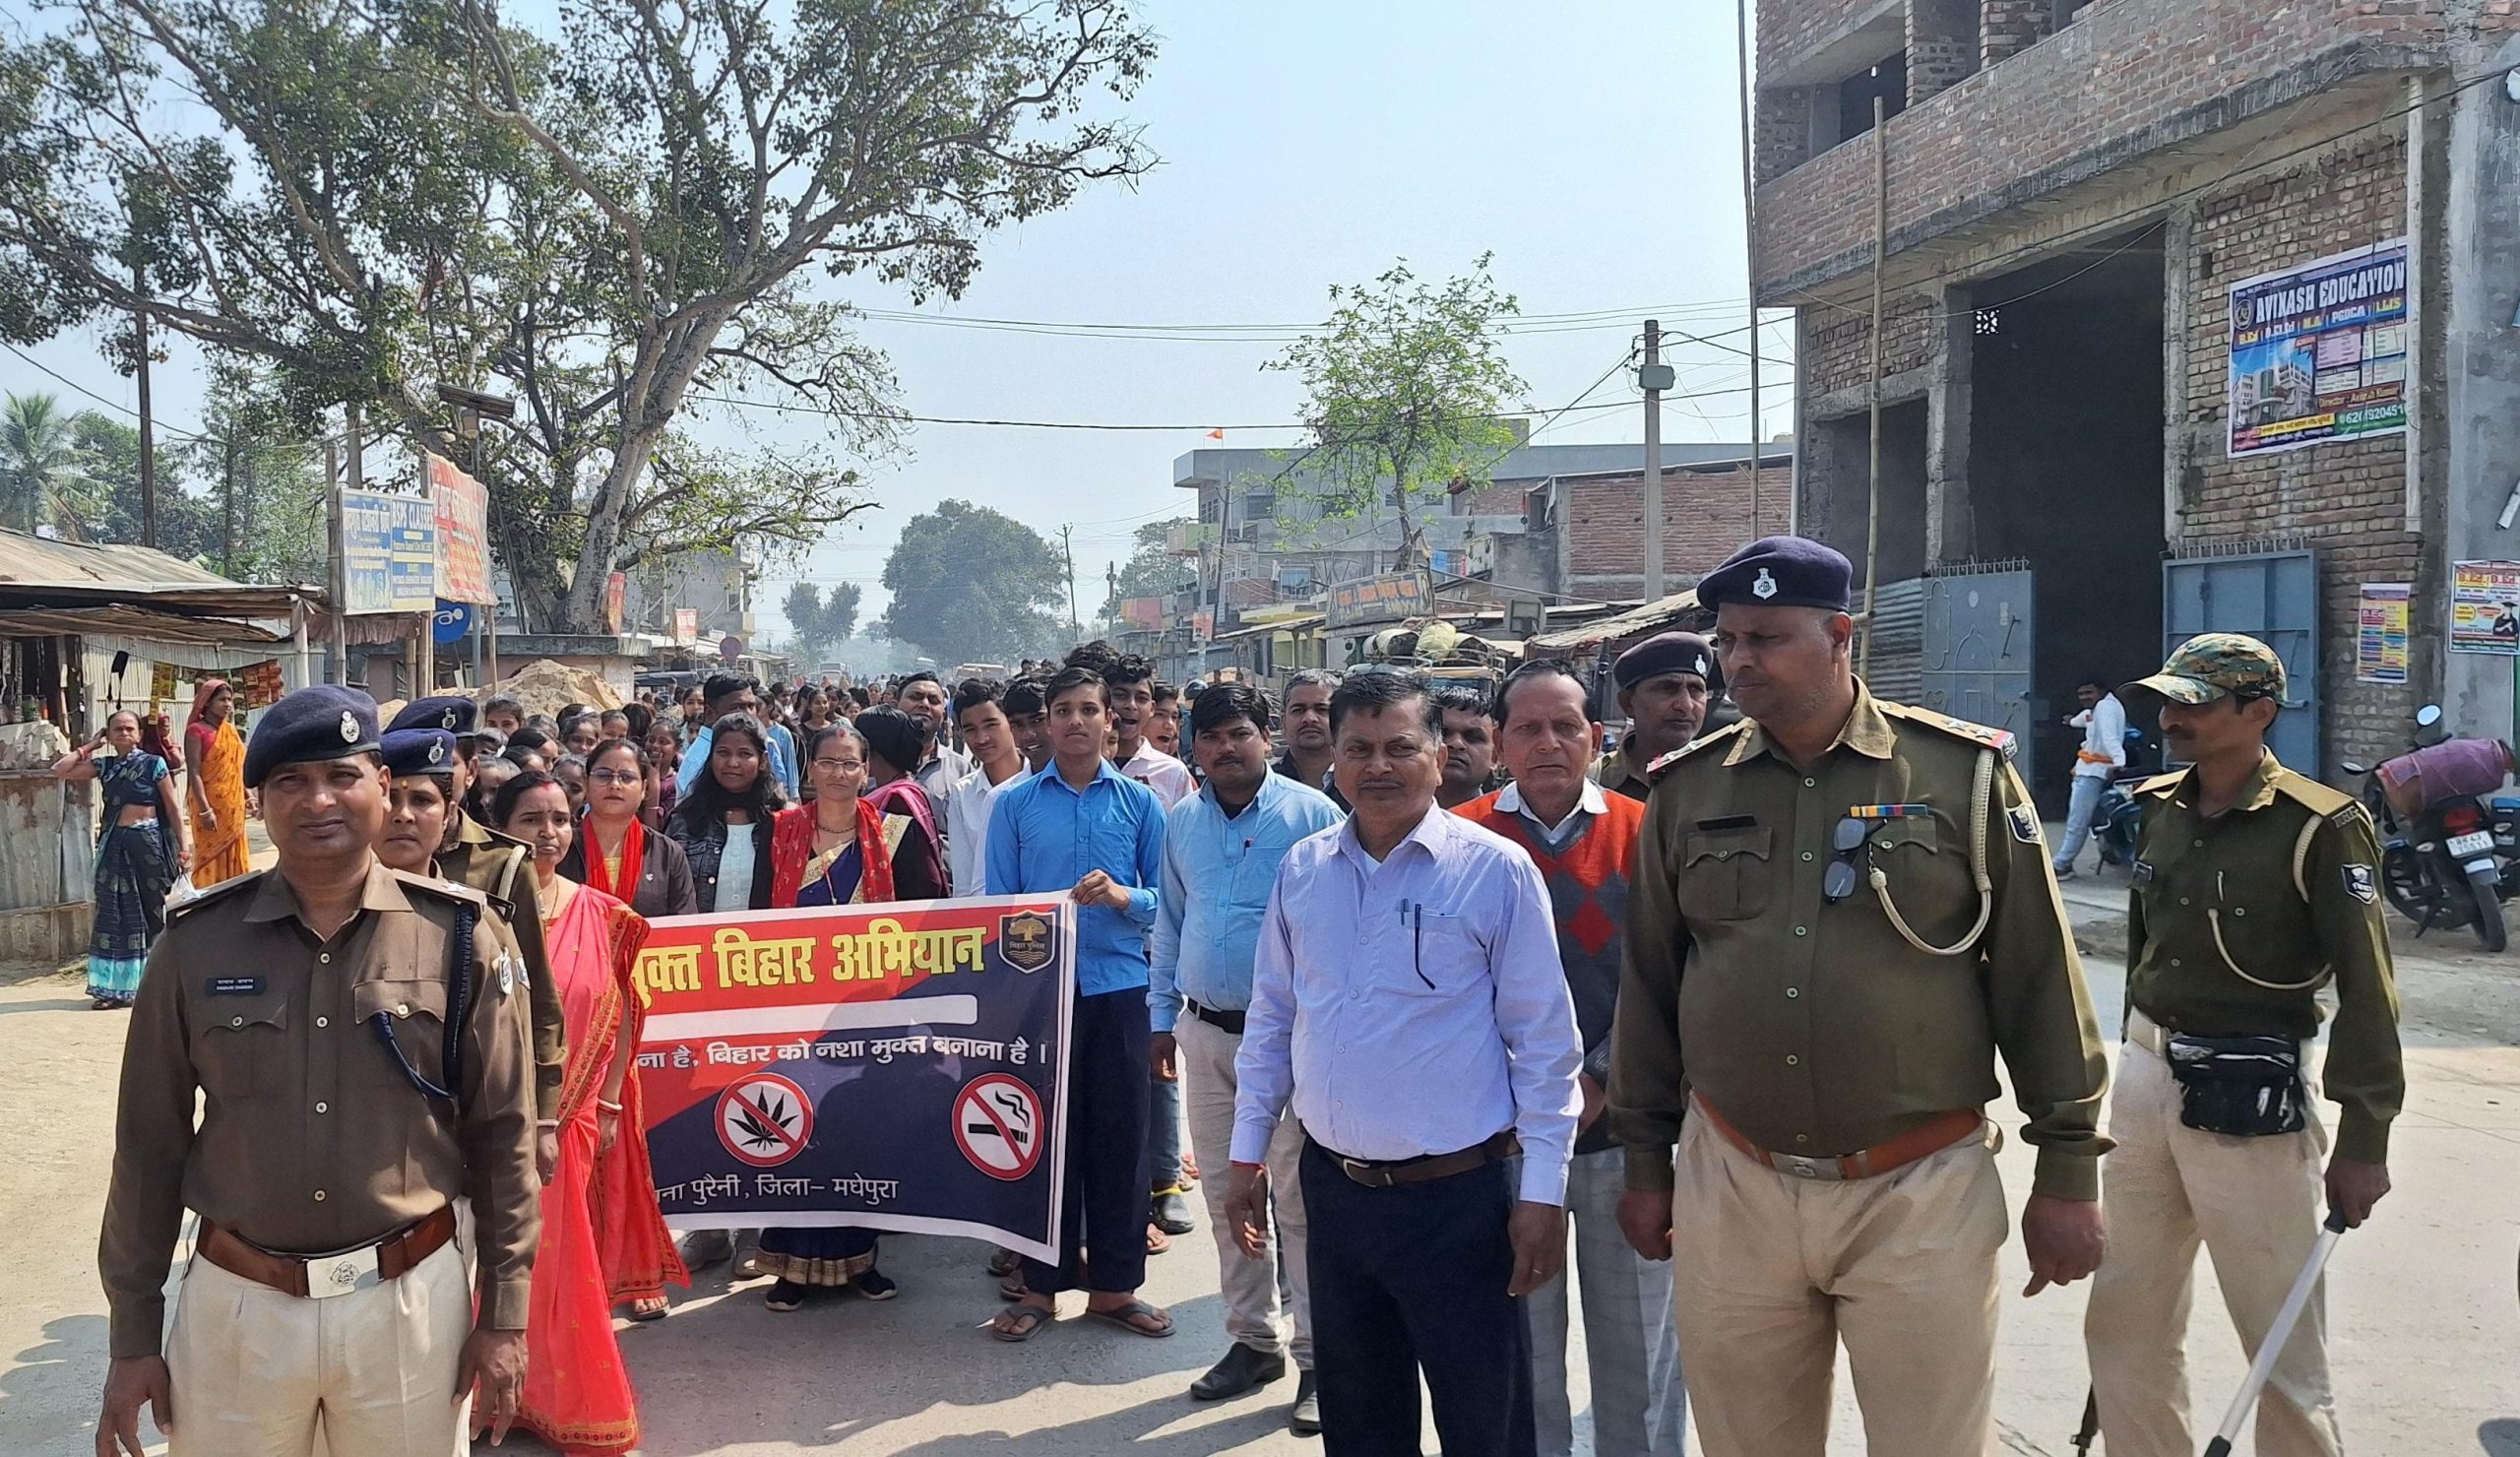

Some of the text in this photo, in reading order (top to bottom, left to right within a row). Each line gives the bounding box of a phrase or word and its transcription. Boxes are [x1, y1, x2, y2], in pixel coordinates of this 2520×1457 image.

[2256, 284, 2315, 324] AVINASH
[2318, 262, 2405, 308] EDUCATION
[713, 926, 817, 989] बिहार
[832, 918, 987, 981] अभियान
[706, 1041, 773, 1065] बिहार
[776, 1038, 810, 1061] को
[815, 1040, 866, 1058] नशा
[870, 1035, 928, 1064] मुक्त
[932, 1035, 1004, 1061] बनाना
[1009, 1035, 1030, 1065] है
[833, 1172, 899, 1204] मधेपुरा
